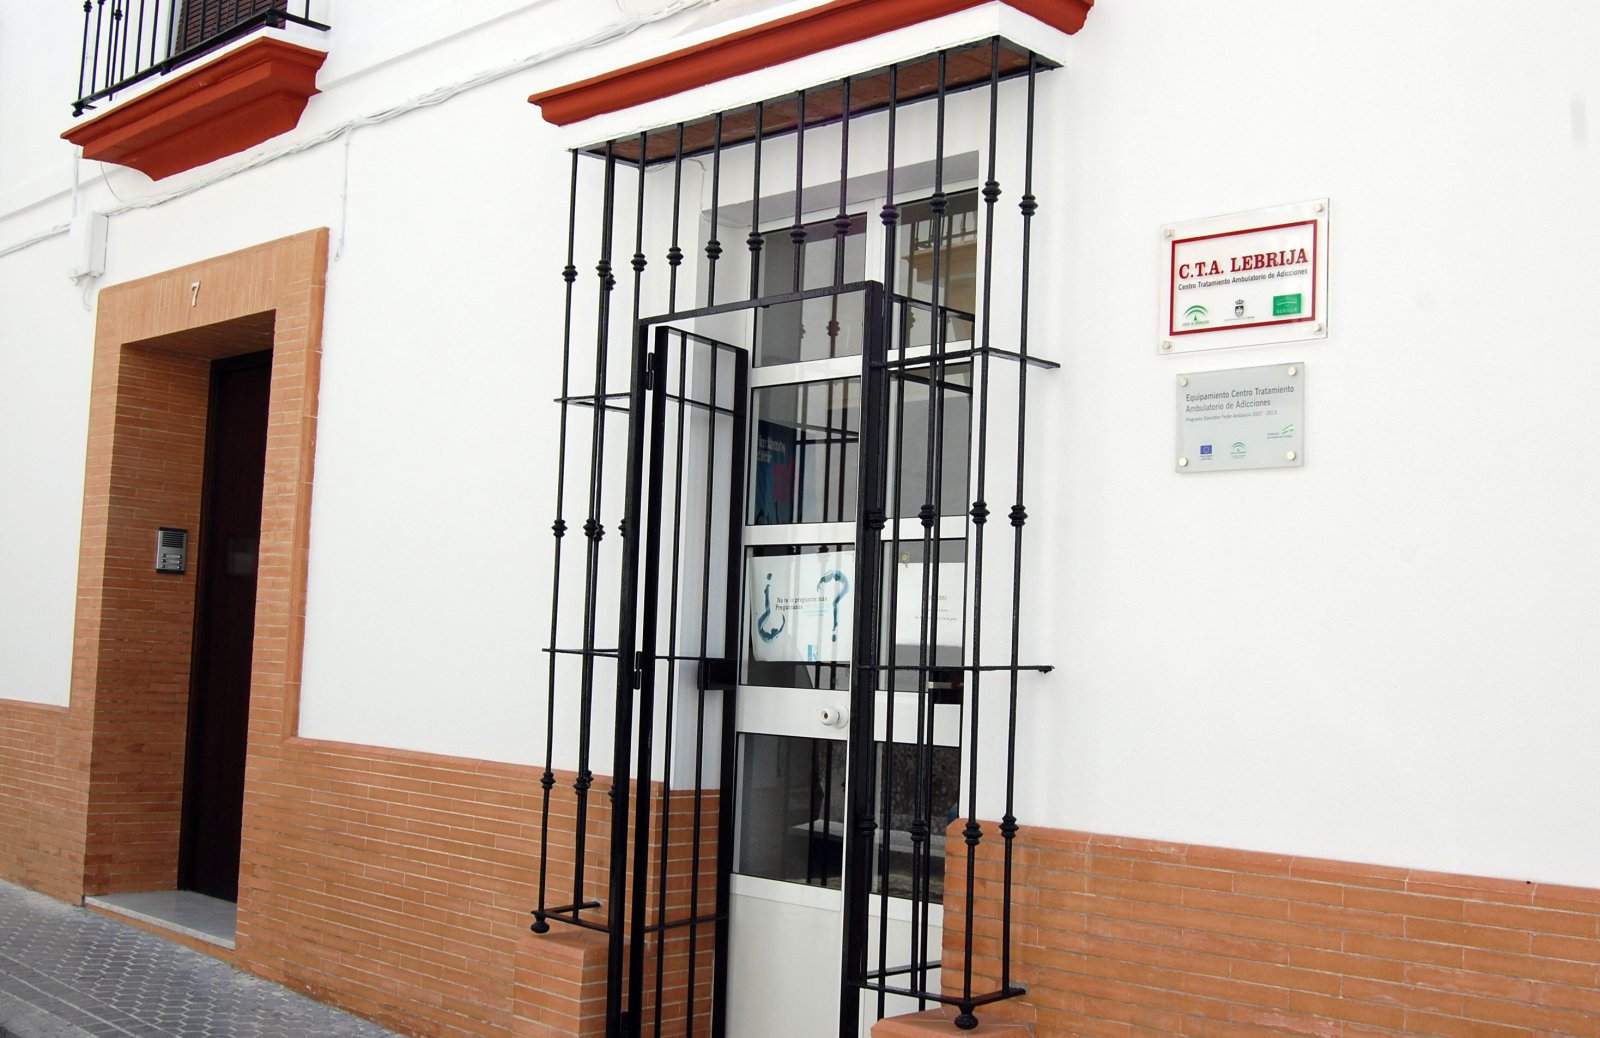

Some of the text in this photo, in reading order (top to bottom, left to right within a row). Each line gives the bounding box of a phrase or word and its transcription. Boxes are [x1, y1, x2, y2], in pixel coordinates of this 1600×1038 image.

[1178, 248, 1308, 279] C.T.A. LEBRIJA
[1178, 268, 1308, 291] Centro Tratamiento Ambulatorio de Adicciones
[191, 280, 201, 307] 7
[1185, 385, 1295, 402] Equipamiento Centro Tratamiento
[1185, 399, 1271, 413] Ambulatorio de Adicciones
